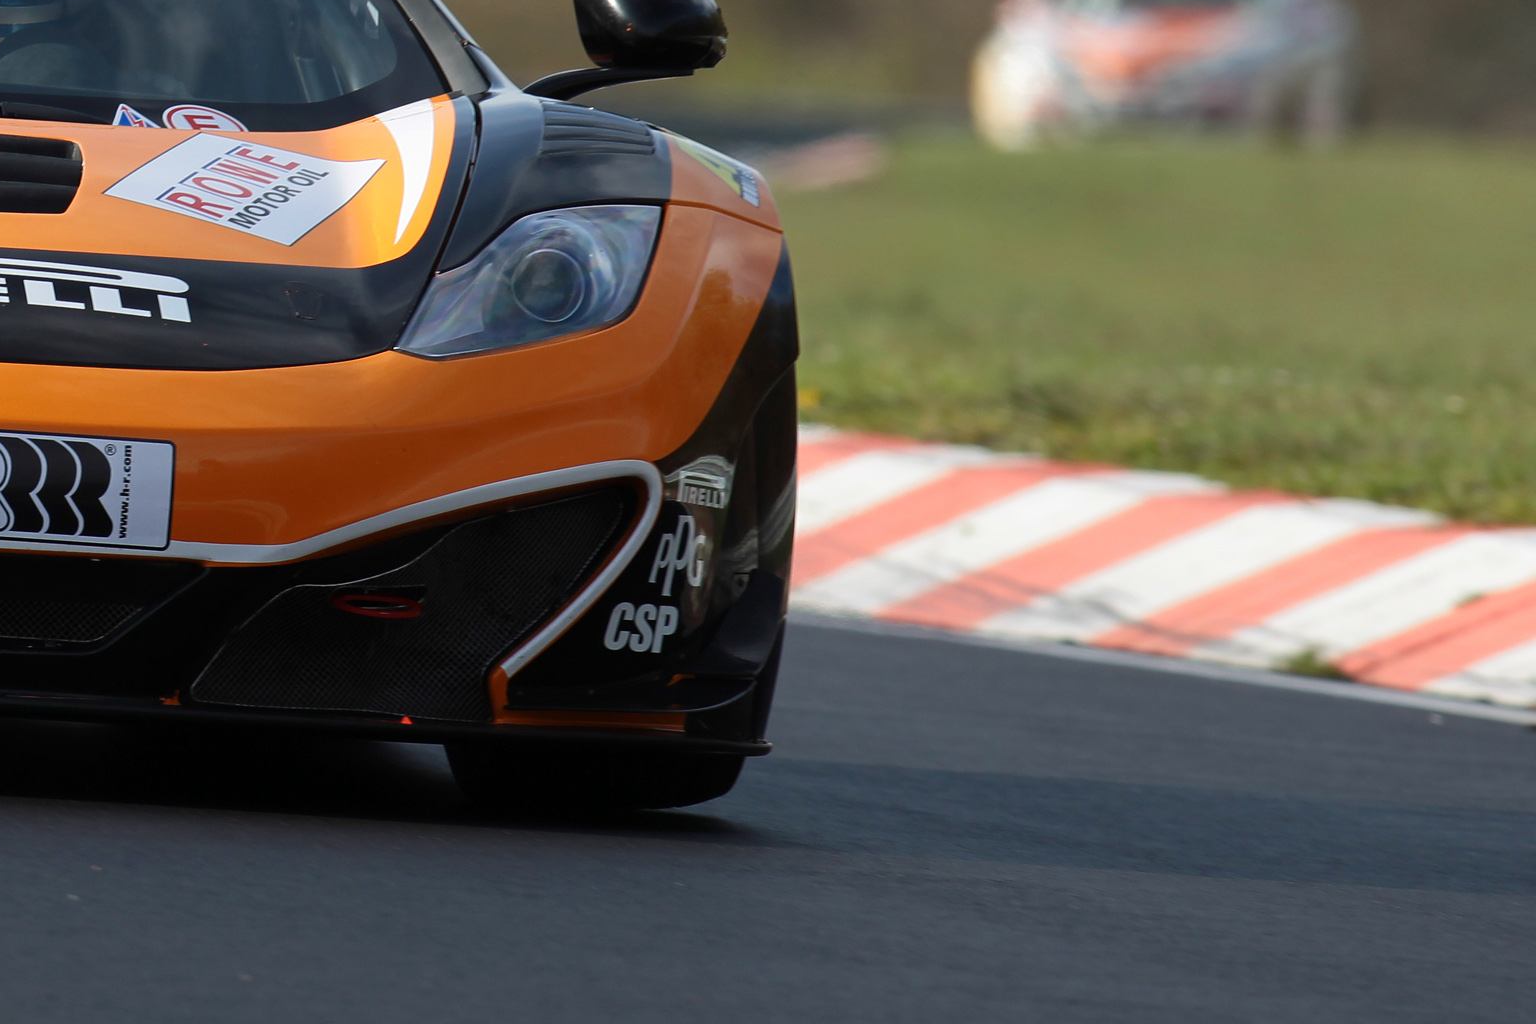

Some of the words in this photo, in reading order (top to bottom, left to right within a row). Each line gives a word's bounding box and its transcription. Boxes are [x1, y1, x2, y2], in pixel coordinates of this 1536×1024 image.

[165, 148, 301, 218] ROWE
[227, 185, 302, 229] MOTOR
[287, 168, 330, 187] OIL
[119, 444, 133, 539] www.h-r.com
[677, 471, 727, 509] PIRELLI
[604, 602, 679, 653] CSP
